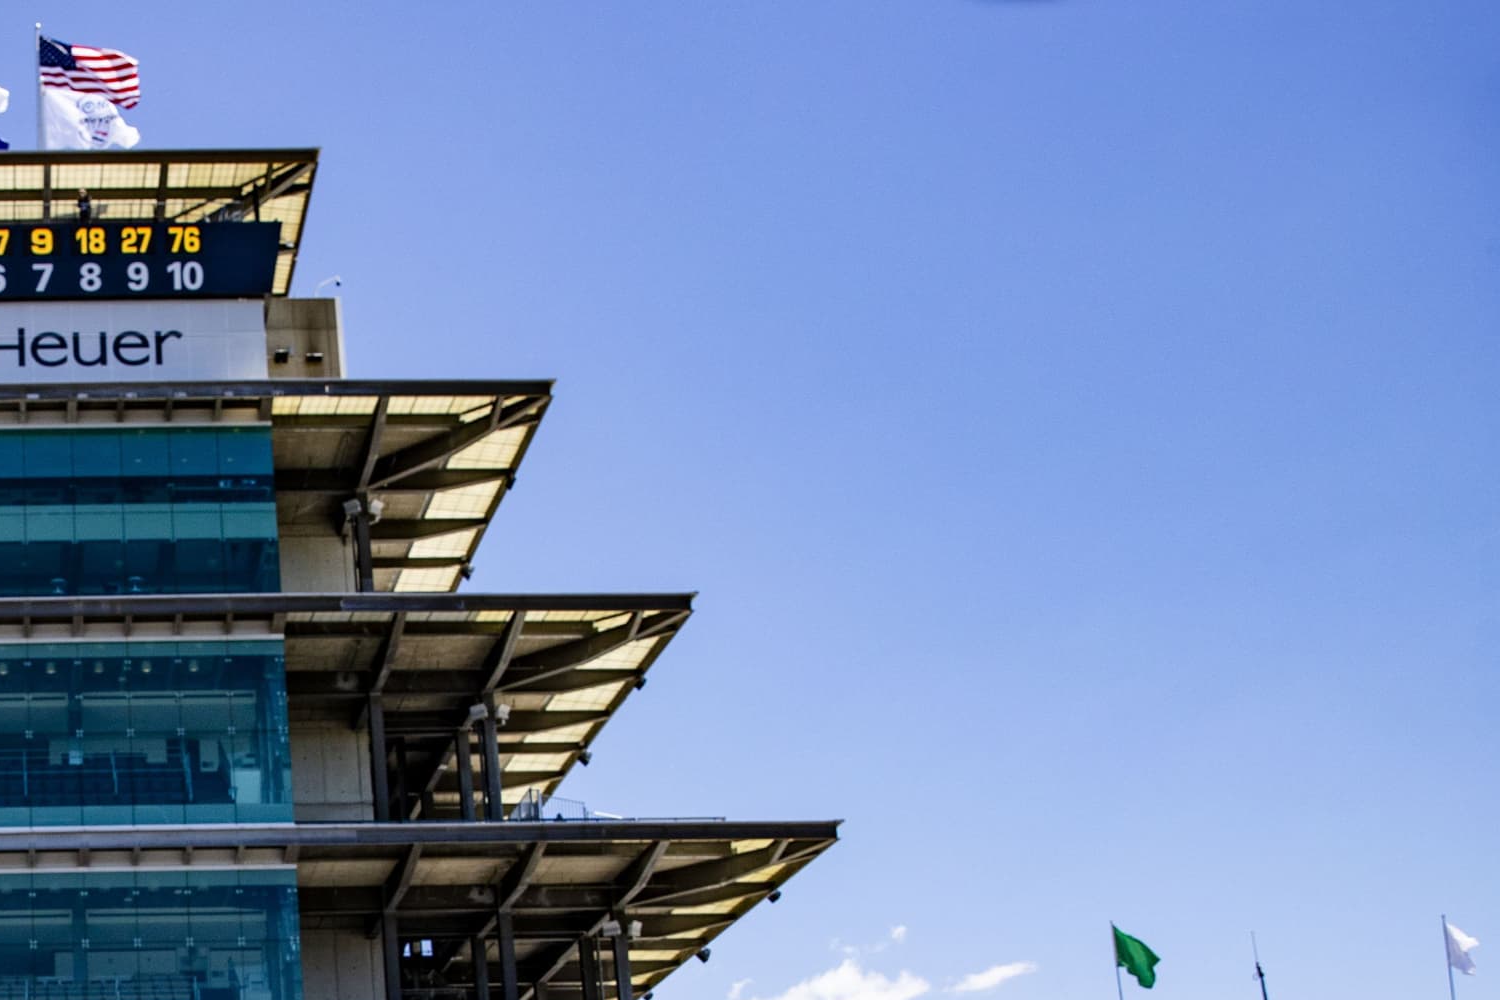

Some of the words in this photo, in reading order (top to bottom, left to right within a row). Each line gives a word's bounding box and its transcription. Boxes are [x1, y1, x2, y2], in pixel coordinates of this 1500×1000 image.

[31, 228, 54, 255] 9
[75, 227, 106, 255] 18
[121, 226, 152, 254] 27
[168, 226, 201, 254] 76
[32, 263, 54, 293] 7
[79, 262, 102, 292] 8
[127, 261, 150, 292] 9
[166, 261, 205, 291] 10
